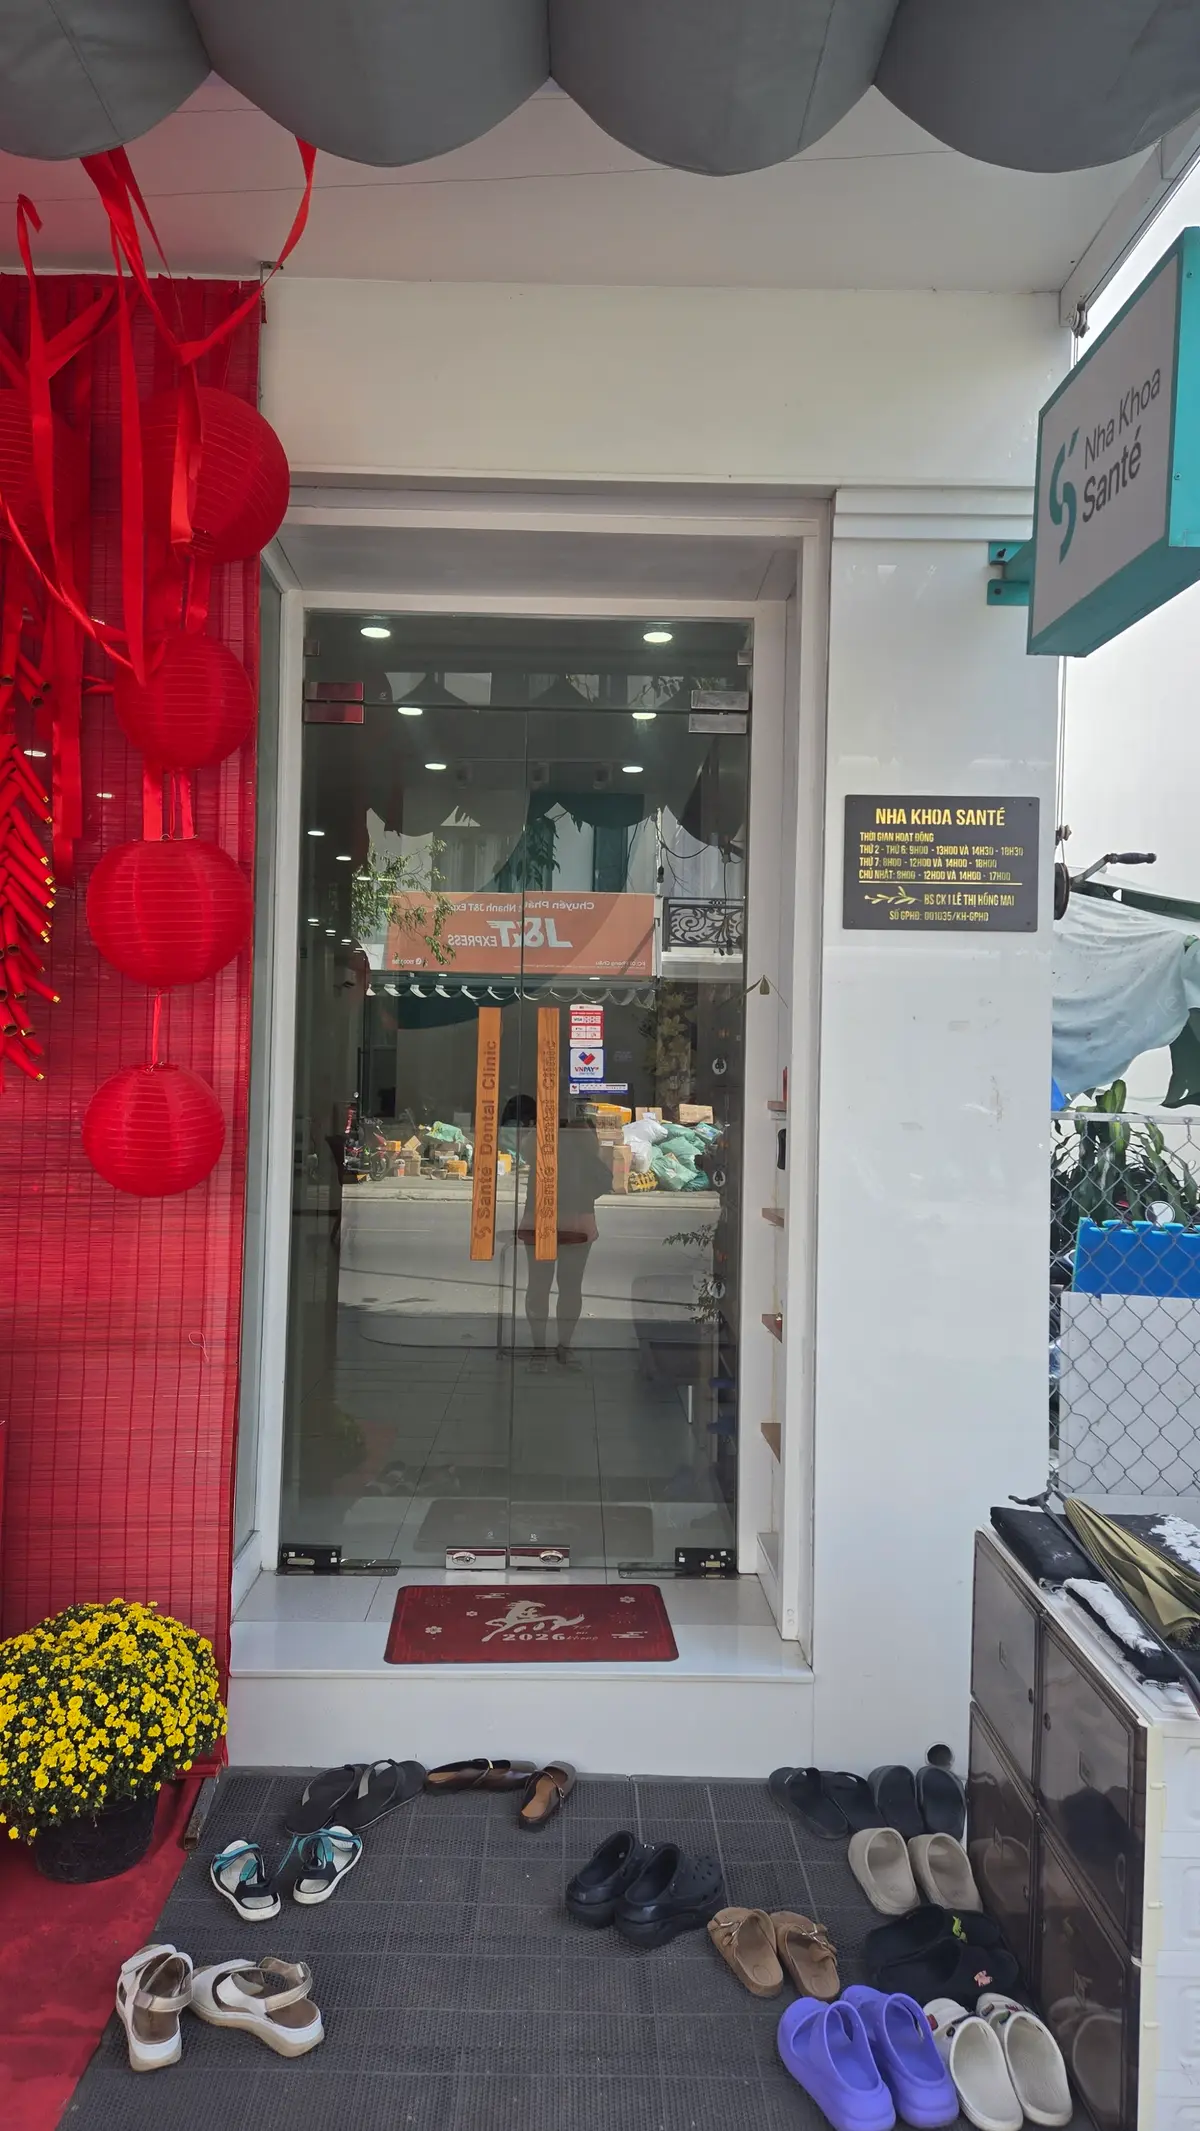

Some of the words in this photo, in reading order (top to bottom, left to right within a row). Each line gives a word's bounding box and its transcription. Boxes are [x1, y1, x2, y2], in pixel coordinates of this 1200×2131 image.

[1084, 418, 1115, 470] Nha
[1118, 368, 1161, 435] Khoa
[1082, 425, 1142, 523] Santé
[875, 808, 907, 825] NHA
[911, 808, 952, 825] KHOA
[956, 807, 1006, 826] SANTÉ
[877, 832, 894, 842] GIAN
[874, 845, 880, 854] 2
[936, 845, 958, 855] 13H00
[972, 846, 994, 856] 14H30
[909, 858, 932, 868] 12H00
[945, 858, 968, 868] 14H00
[923, 870, 946, 880] 12H00
[959, 871, 982, 881] 14H00
[924, 893, 934, 905] BS
[936, 893, 947, 906] CK
[952, 892, 962, 906] LÊ
[1000, 895, 1015, 907] MAI
[482, 1040, 497, 1091] Clinic
[502, 1633, 565, 1641] 2026
